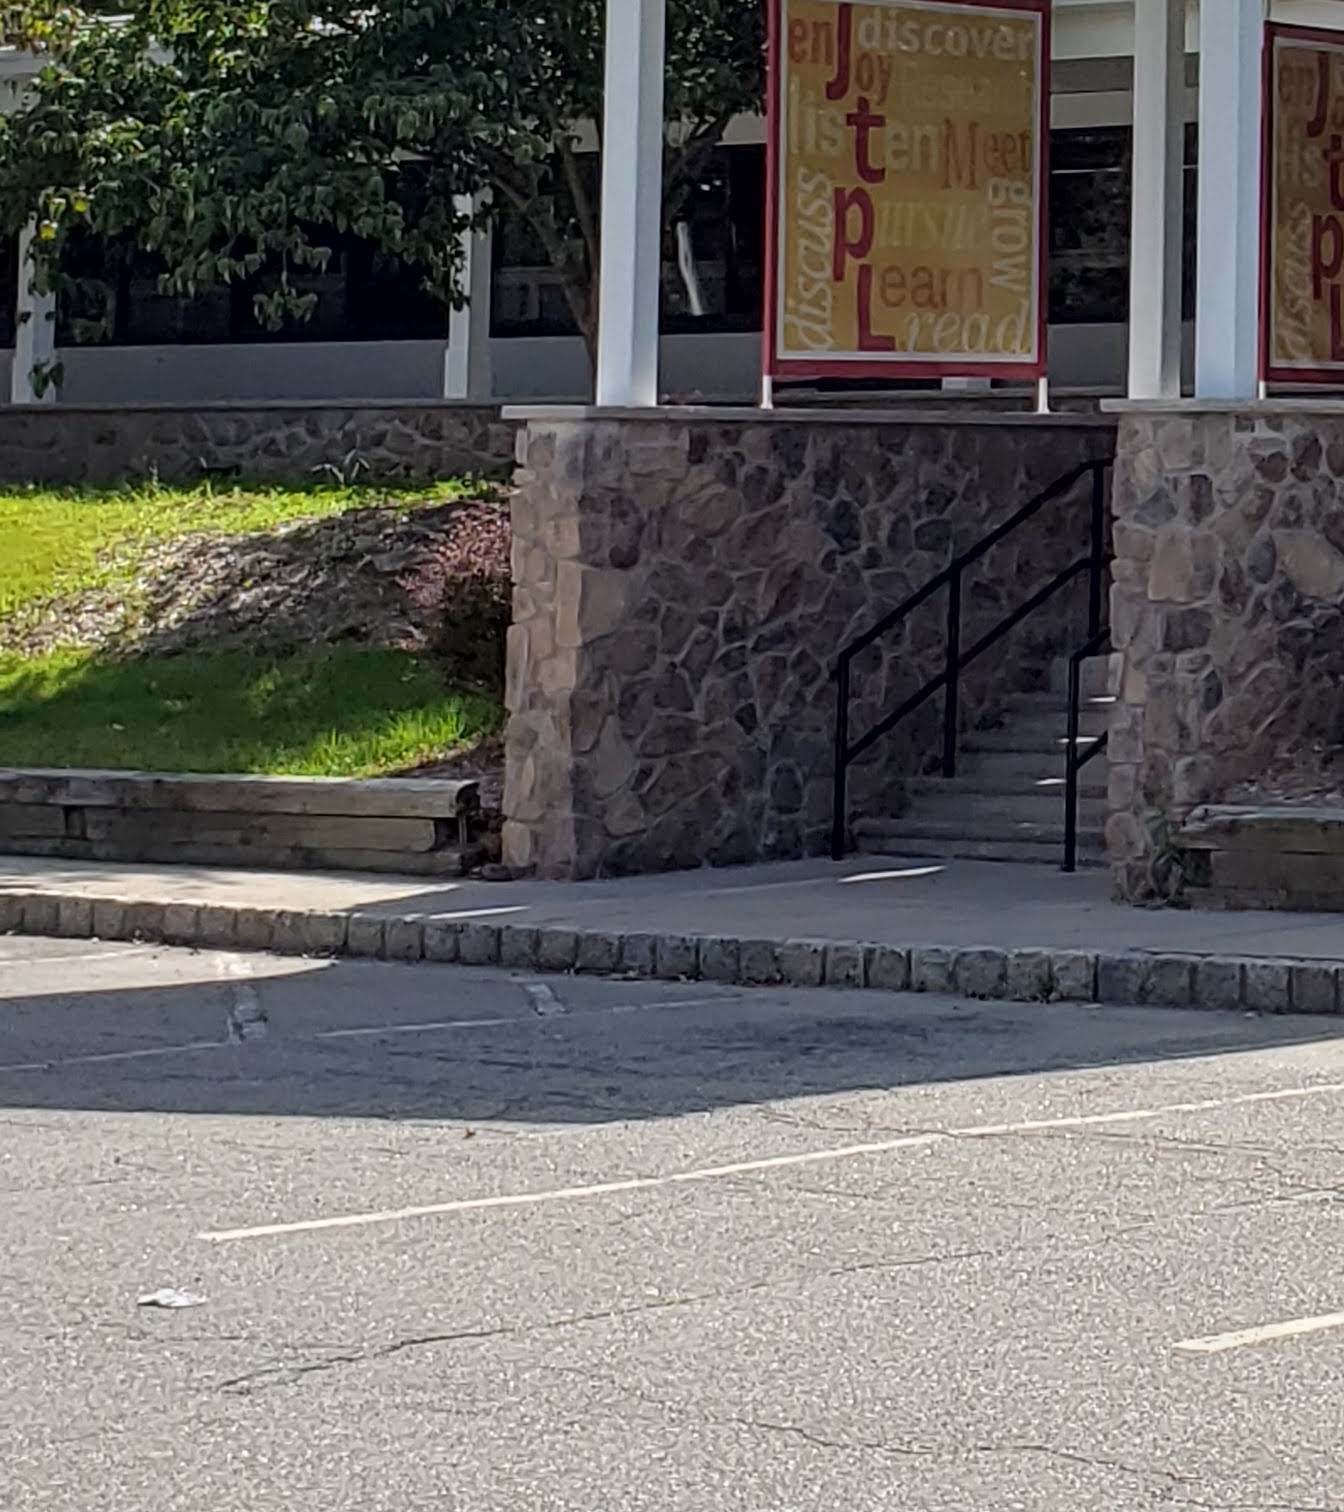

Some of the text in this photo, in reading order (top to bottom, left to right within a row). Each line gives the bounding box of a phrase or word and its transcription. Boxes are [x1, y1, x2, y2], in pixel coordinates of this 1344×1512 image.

[857, 6, 1034, 61] discover
[784, 167, 834, 351] discuss
[985, 177, 1032, 296] grow
[903, 298, 1030, 355] read
